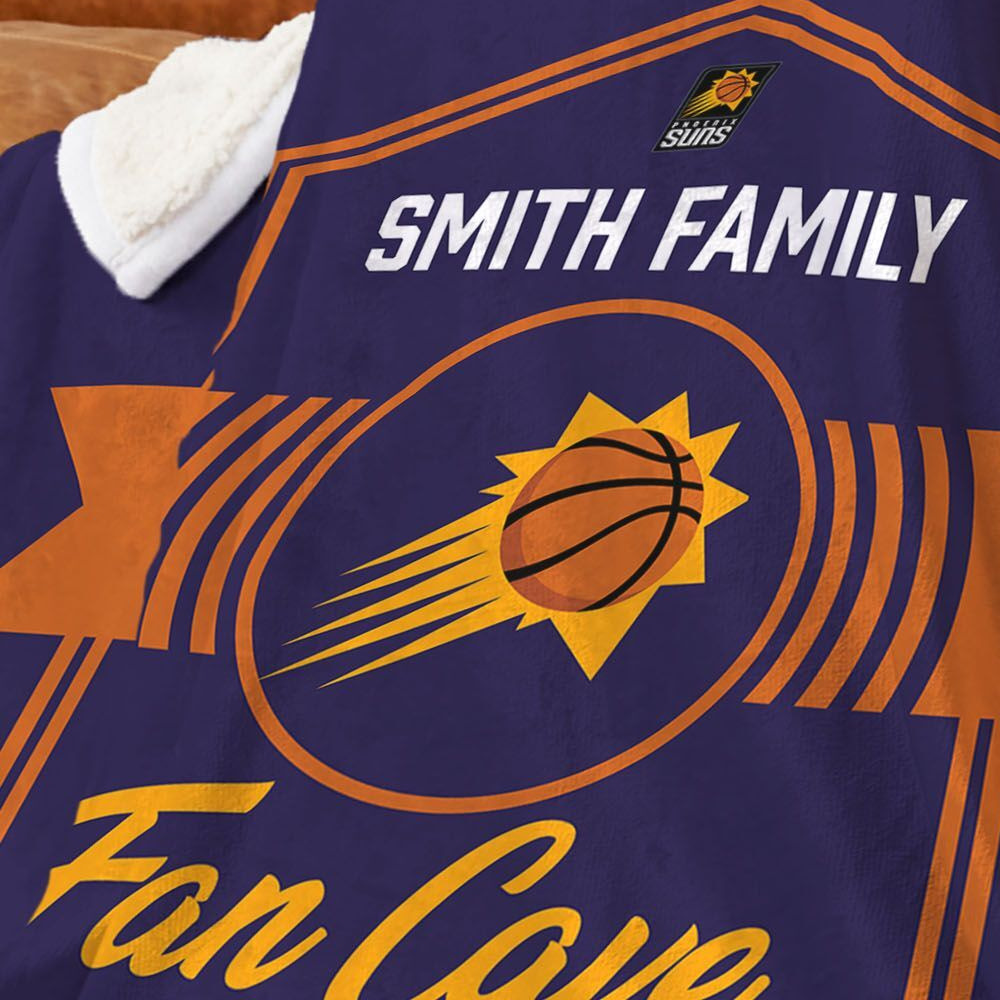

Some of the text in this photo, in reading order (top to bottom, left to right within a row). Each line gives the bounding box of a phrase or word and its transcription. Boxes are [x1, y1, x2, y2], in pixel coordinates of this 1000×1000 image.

[660, 126, 732, 148] SUNS
[365, 184, 968, 284] SMITH FAMILY
[27, 781, 771, 1000] Fan Cave
